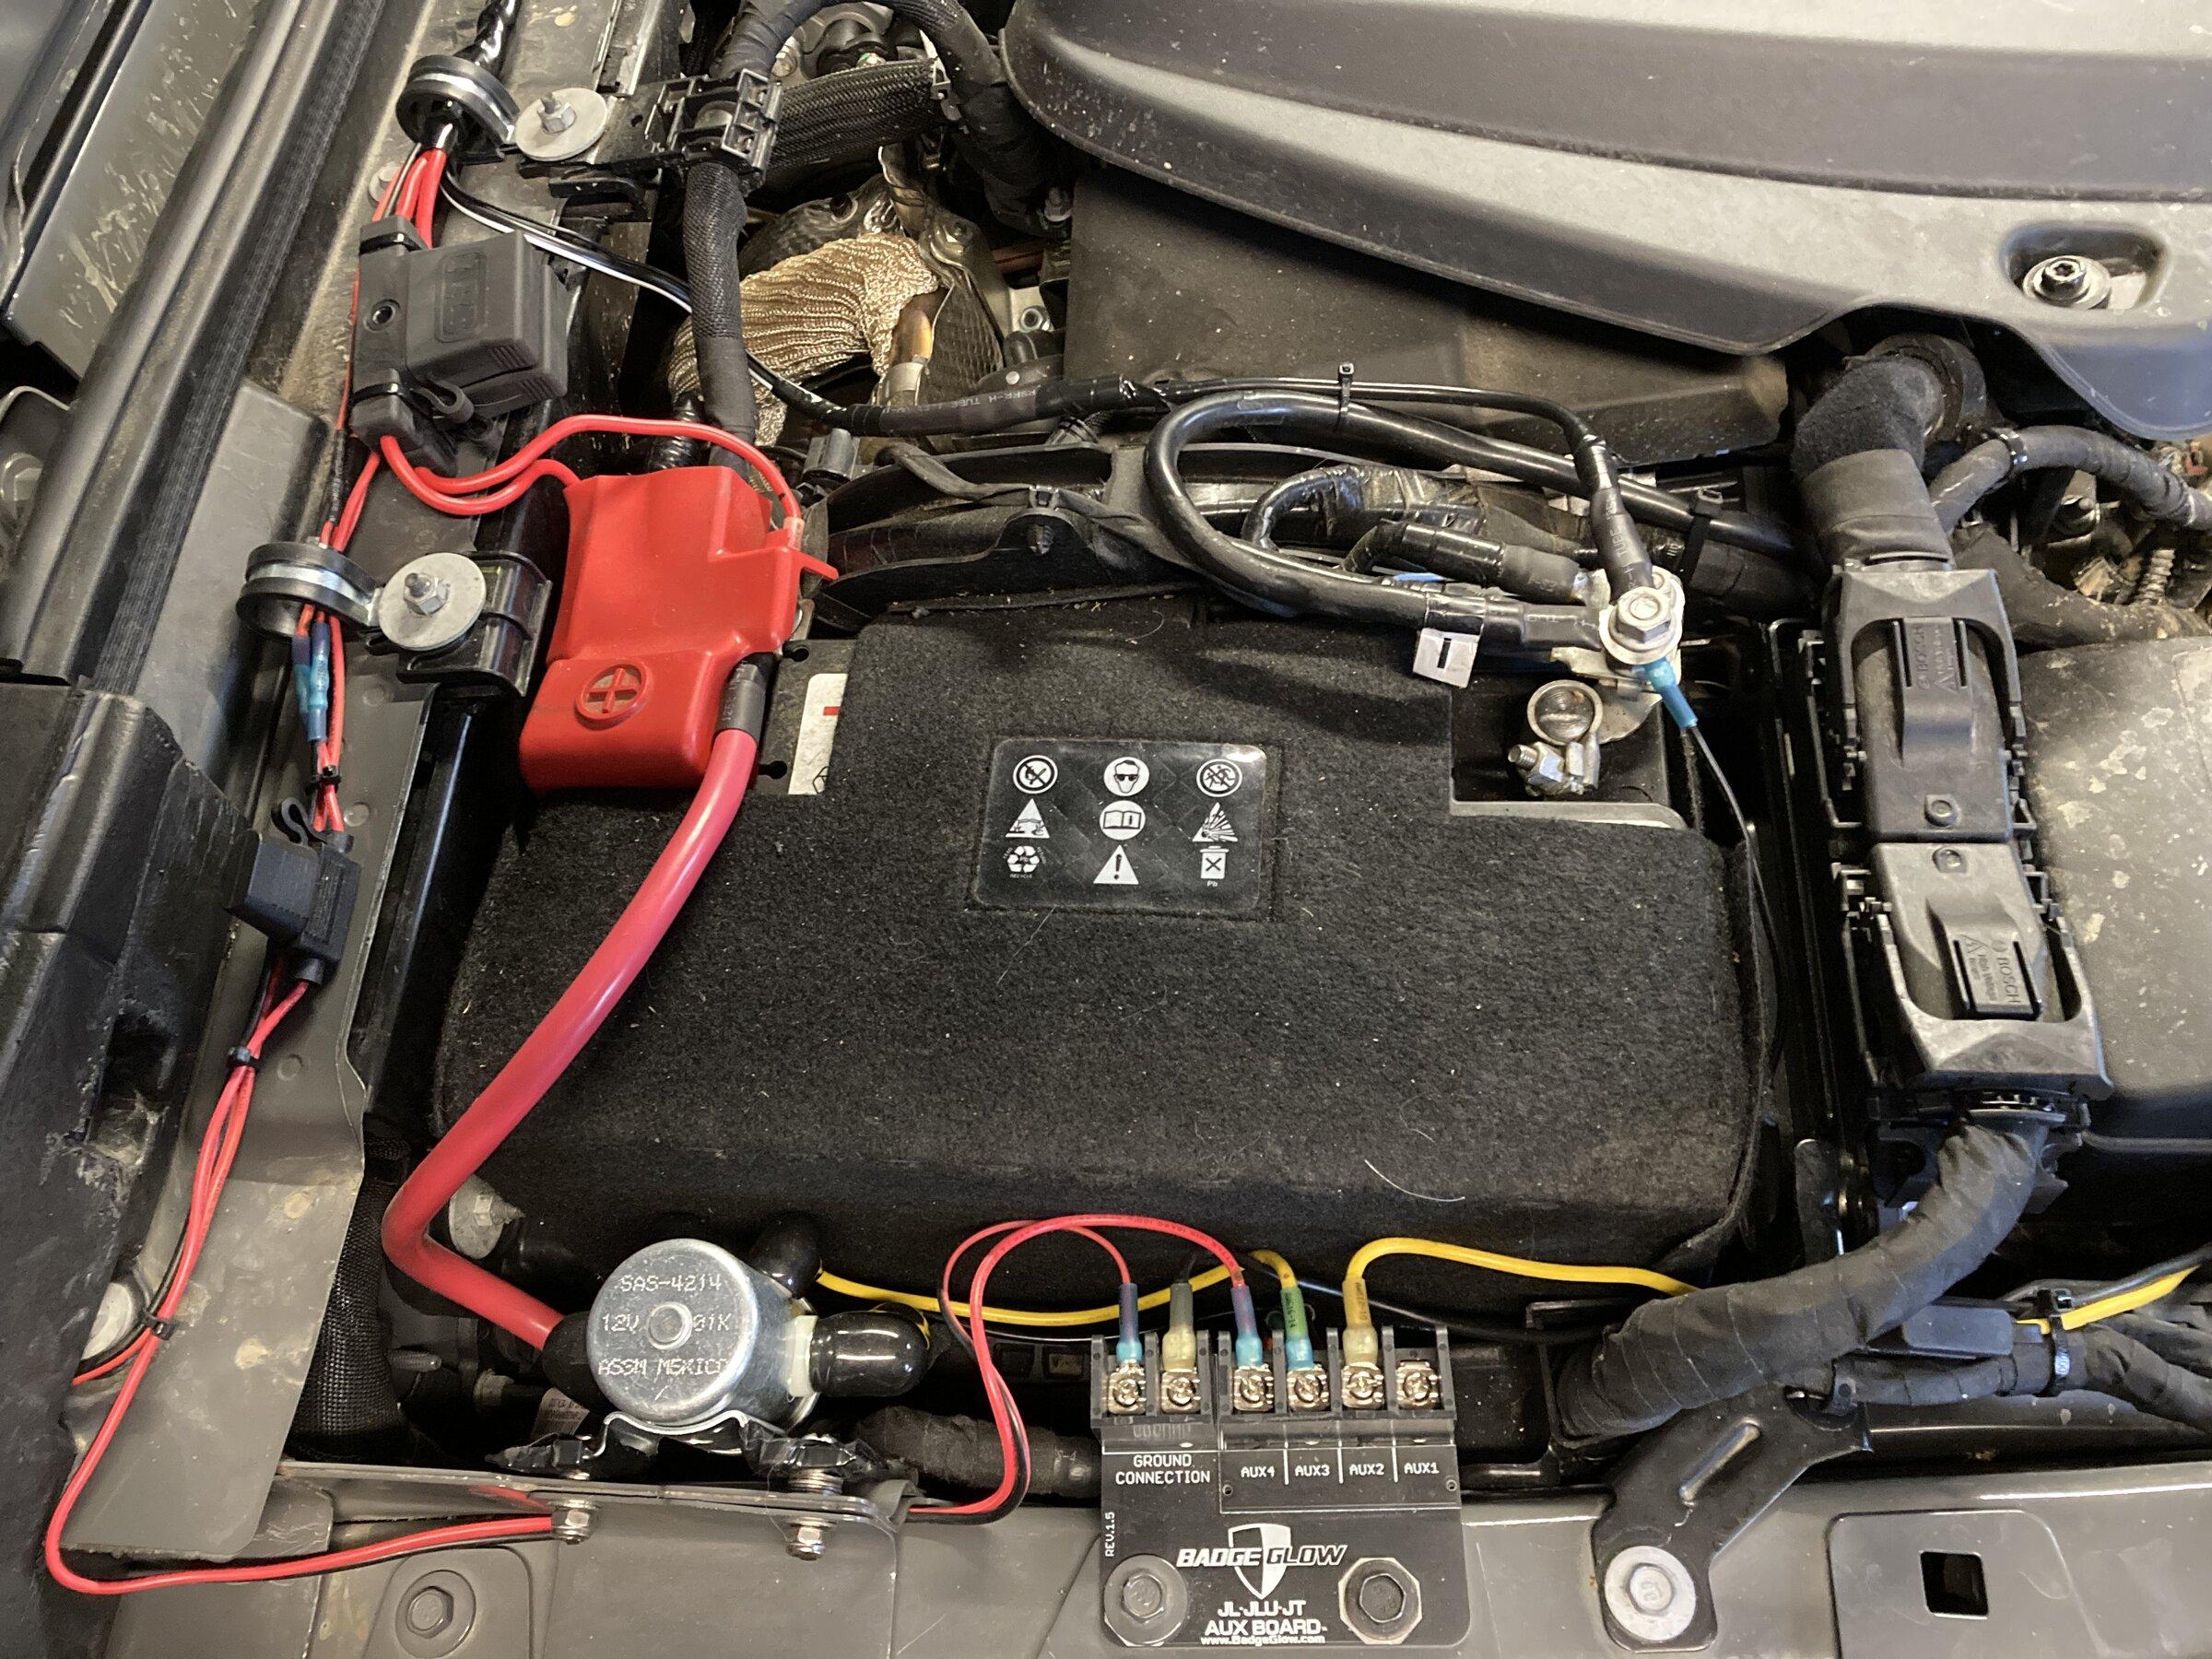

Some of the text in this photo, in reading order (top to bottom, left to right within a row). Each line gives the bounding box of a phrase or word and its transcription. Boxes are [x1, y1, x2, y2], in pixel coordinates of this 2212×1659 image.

[1995, 957, 2022, 1003] BOSCH
[620, 1274, 722, 1292] SAS-4214
[602, 1312, 640, 1334] 12V
[1133, 1454, 1193, 1468] GROUND
[1404, 1462, 1440, 1475] AUX1
[1241, 1465, 1276, 1478] AUX4
[1295, 1464, 1330, 1477] AUX3
[1348, 1463, 1385, 1476] AUX2
[1115, 1470, 1211, 1486] CONNECTION
[1104, 1512, 1116, 1558] REV.1.5
[1175, 1545, 1348, 1568] BADGE GLOW
[1204, 1618, 1322, 1636] AUX BOARD
[1200, 1635, 1326, 1647] www.BadgeGlow.com
